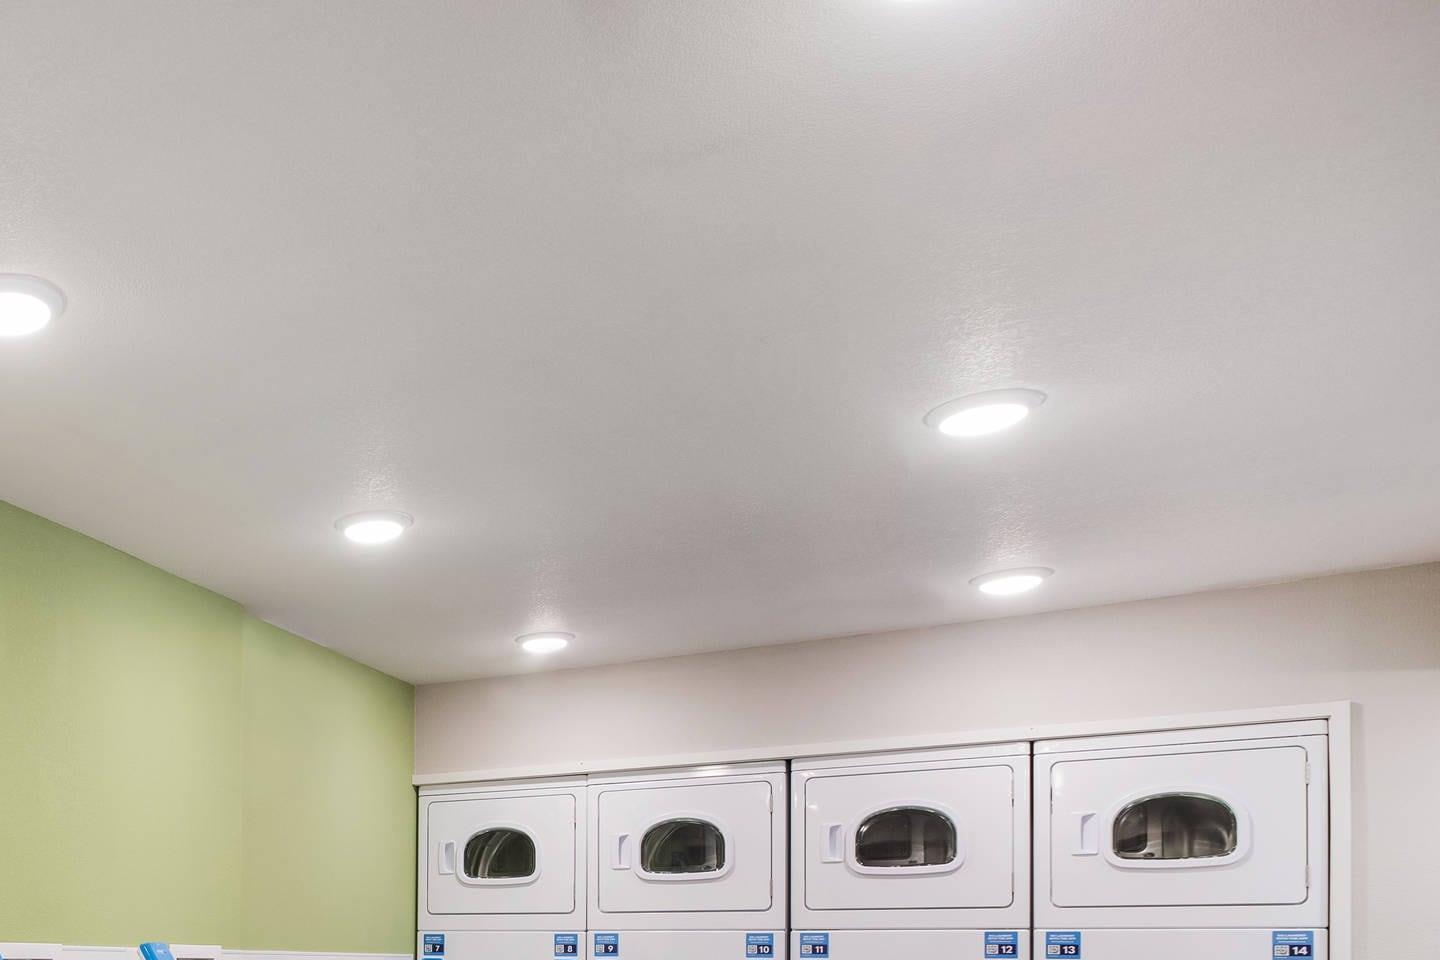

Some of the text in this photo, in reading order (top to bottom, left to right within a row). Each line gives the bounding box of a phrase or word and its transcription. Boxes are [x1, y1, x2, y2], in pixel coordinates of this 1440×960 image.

[567, 945, 573, 953] 8
[1001, 946, 1013, 954] 12
[1062, 945, 1076, 954] 13
[1292, 946, 1308, 955] 14
